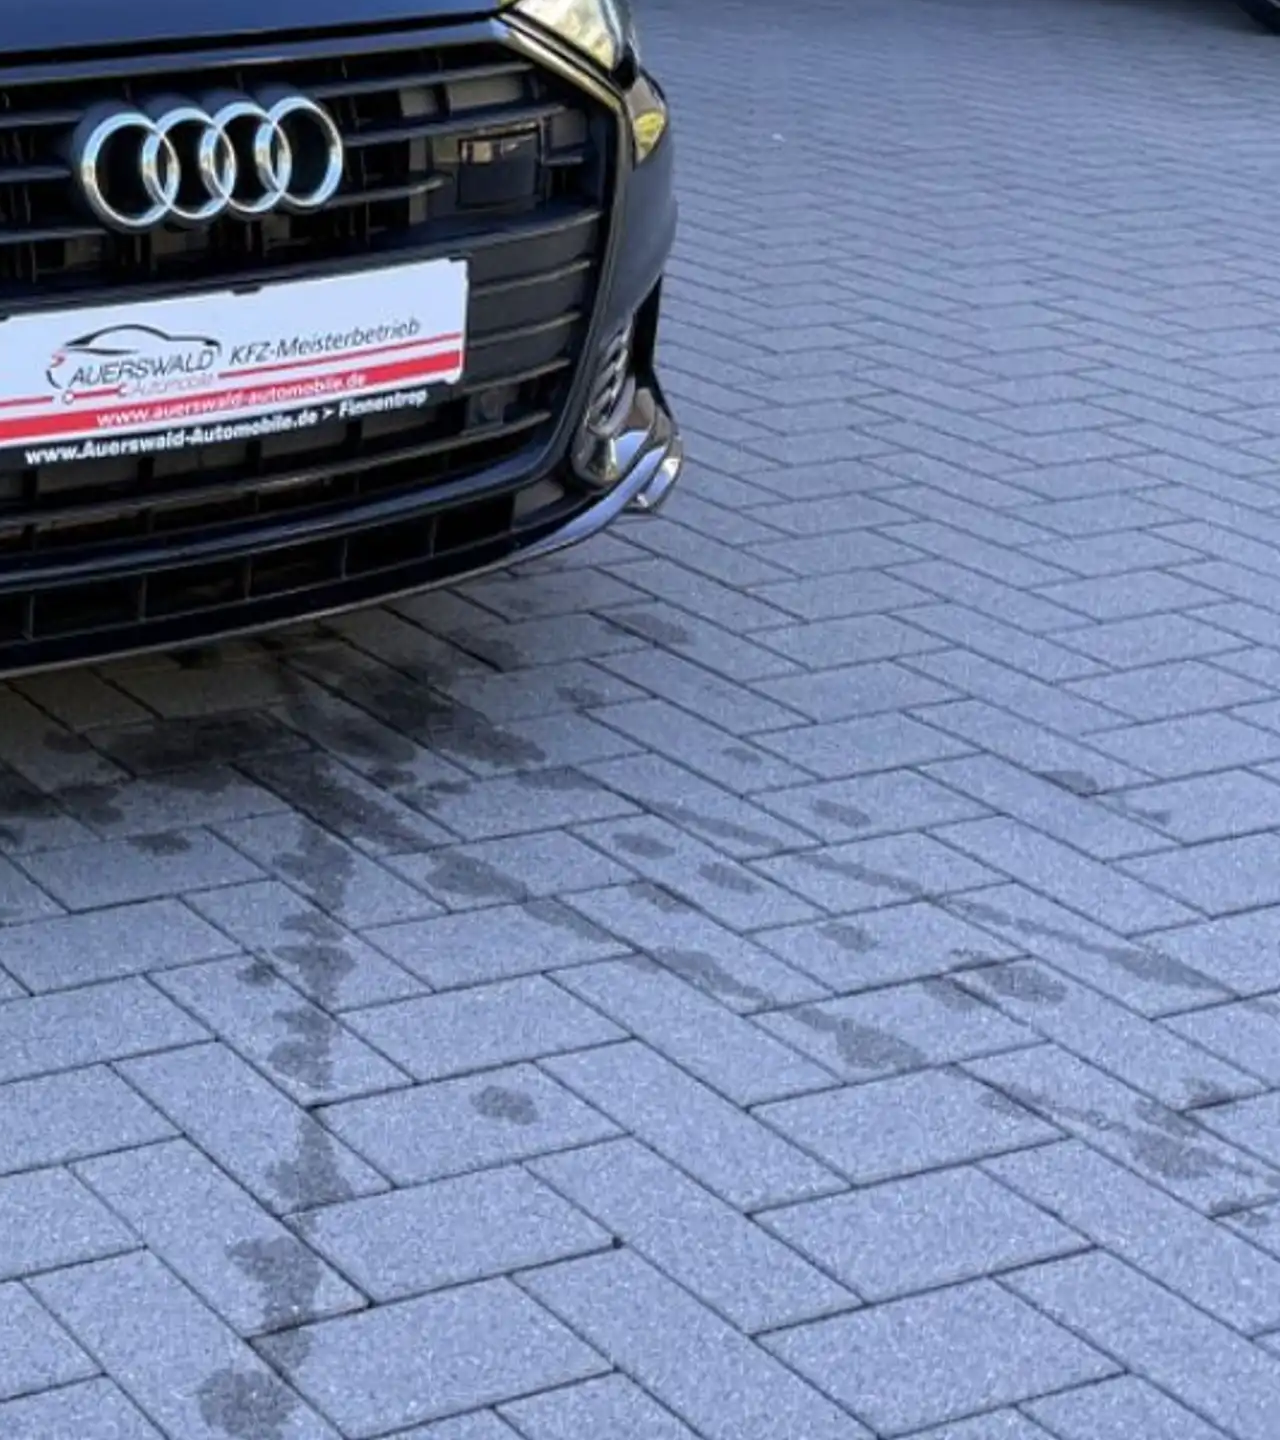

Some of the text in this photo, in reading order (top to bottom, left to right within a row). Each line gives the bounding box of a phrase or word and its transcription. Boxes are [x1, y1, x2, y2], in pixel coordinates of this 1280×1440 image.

[68, 317, 421, 388] AUERSWALD KFZ-Meisterbetrieb
[95, 372, 367, 428] www.auerswald-automobile.de
[25, 410, 319, 465] www.Auerswald-Automobile.de
